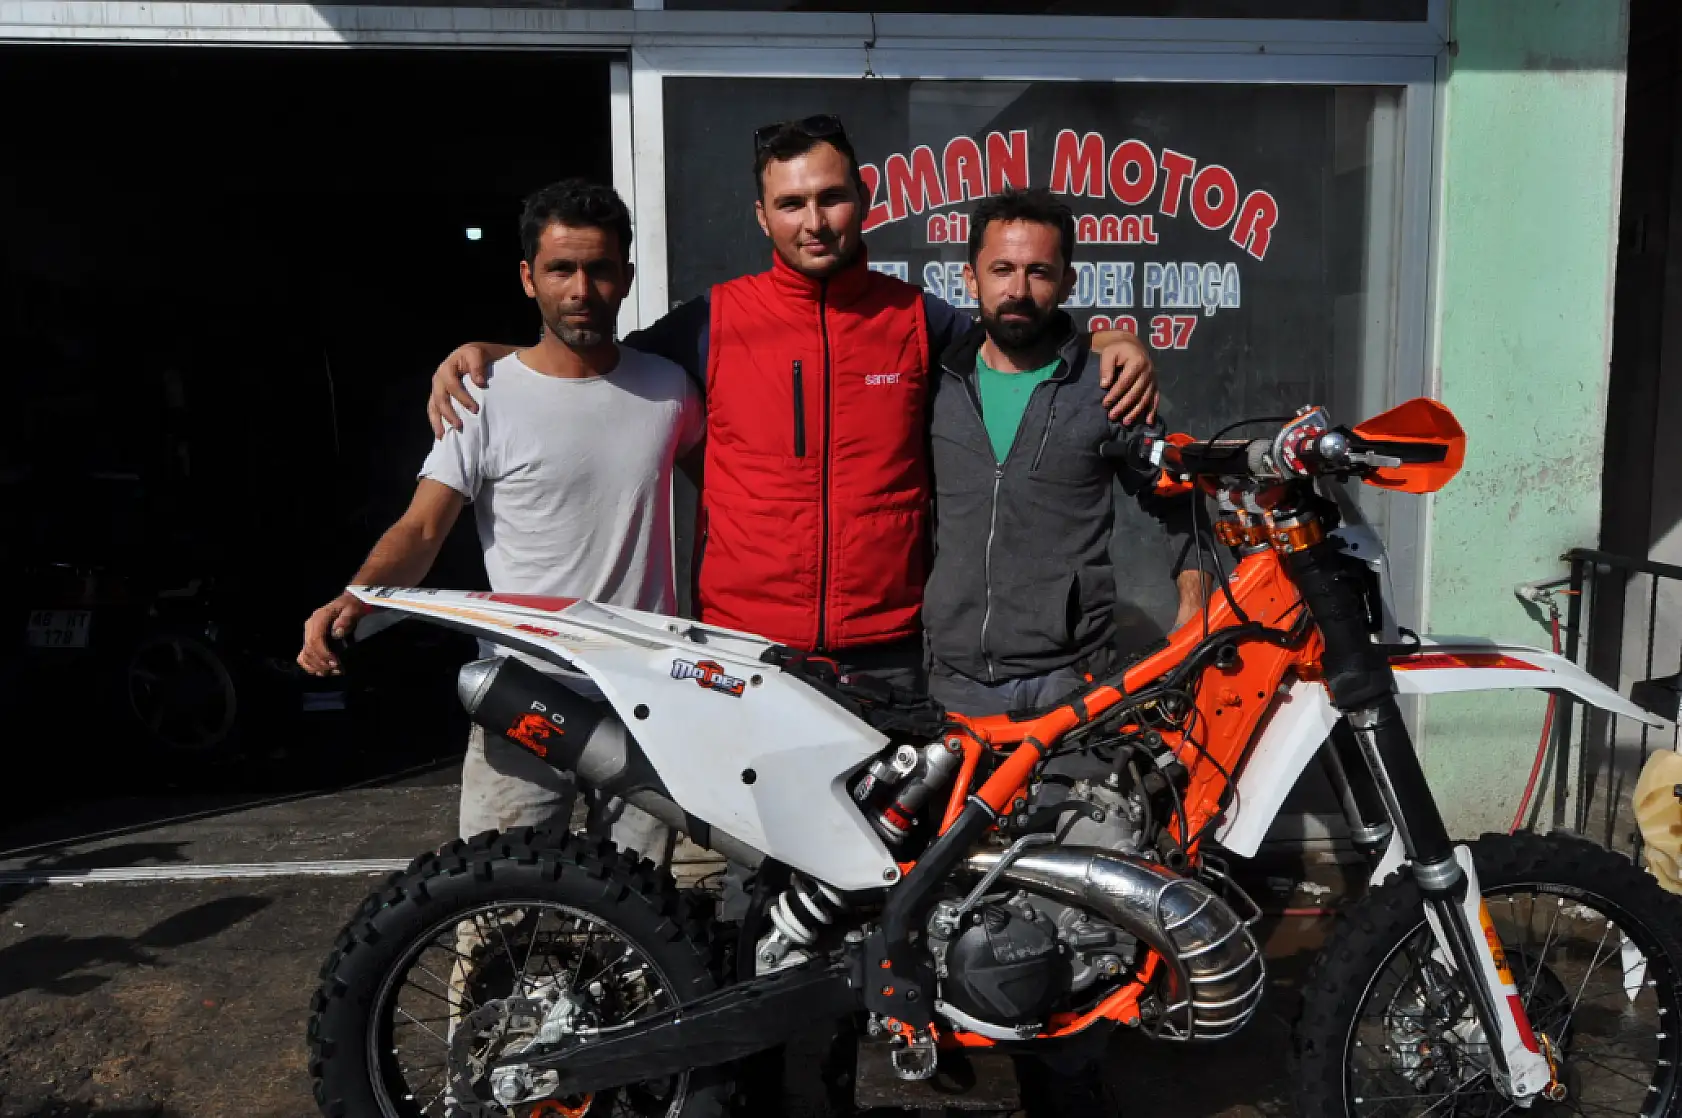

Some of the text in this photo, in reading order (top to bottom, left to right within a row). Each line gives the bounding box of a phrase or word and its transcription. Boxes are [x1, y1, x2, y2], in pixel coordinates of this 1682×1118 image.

[859, 129, 1279, 261] ZMAN MOTOR
[1072, 214, 1159, 244] ARAL
[1060, 261, 1135, 309] DEK
[1143, 261, 1241, 317] PARÇA
[1149, 314, 1198, 349] 37
